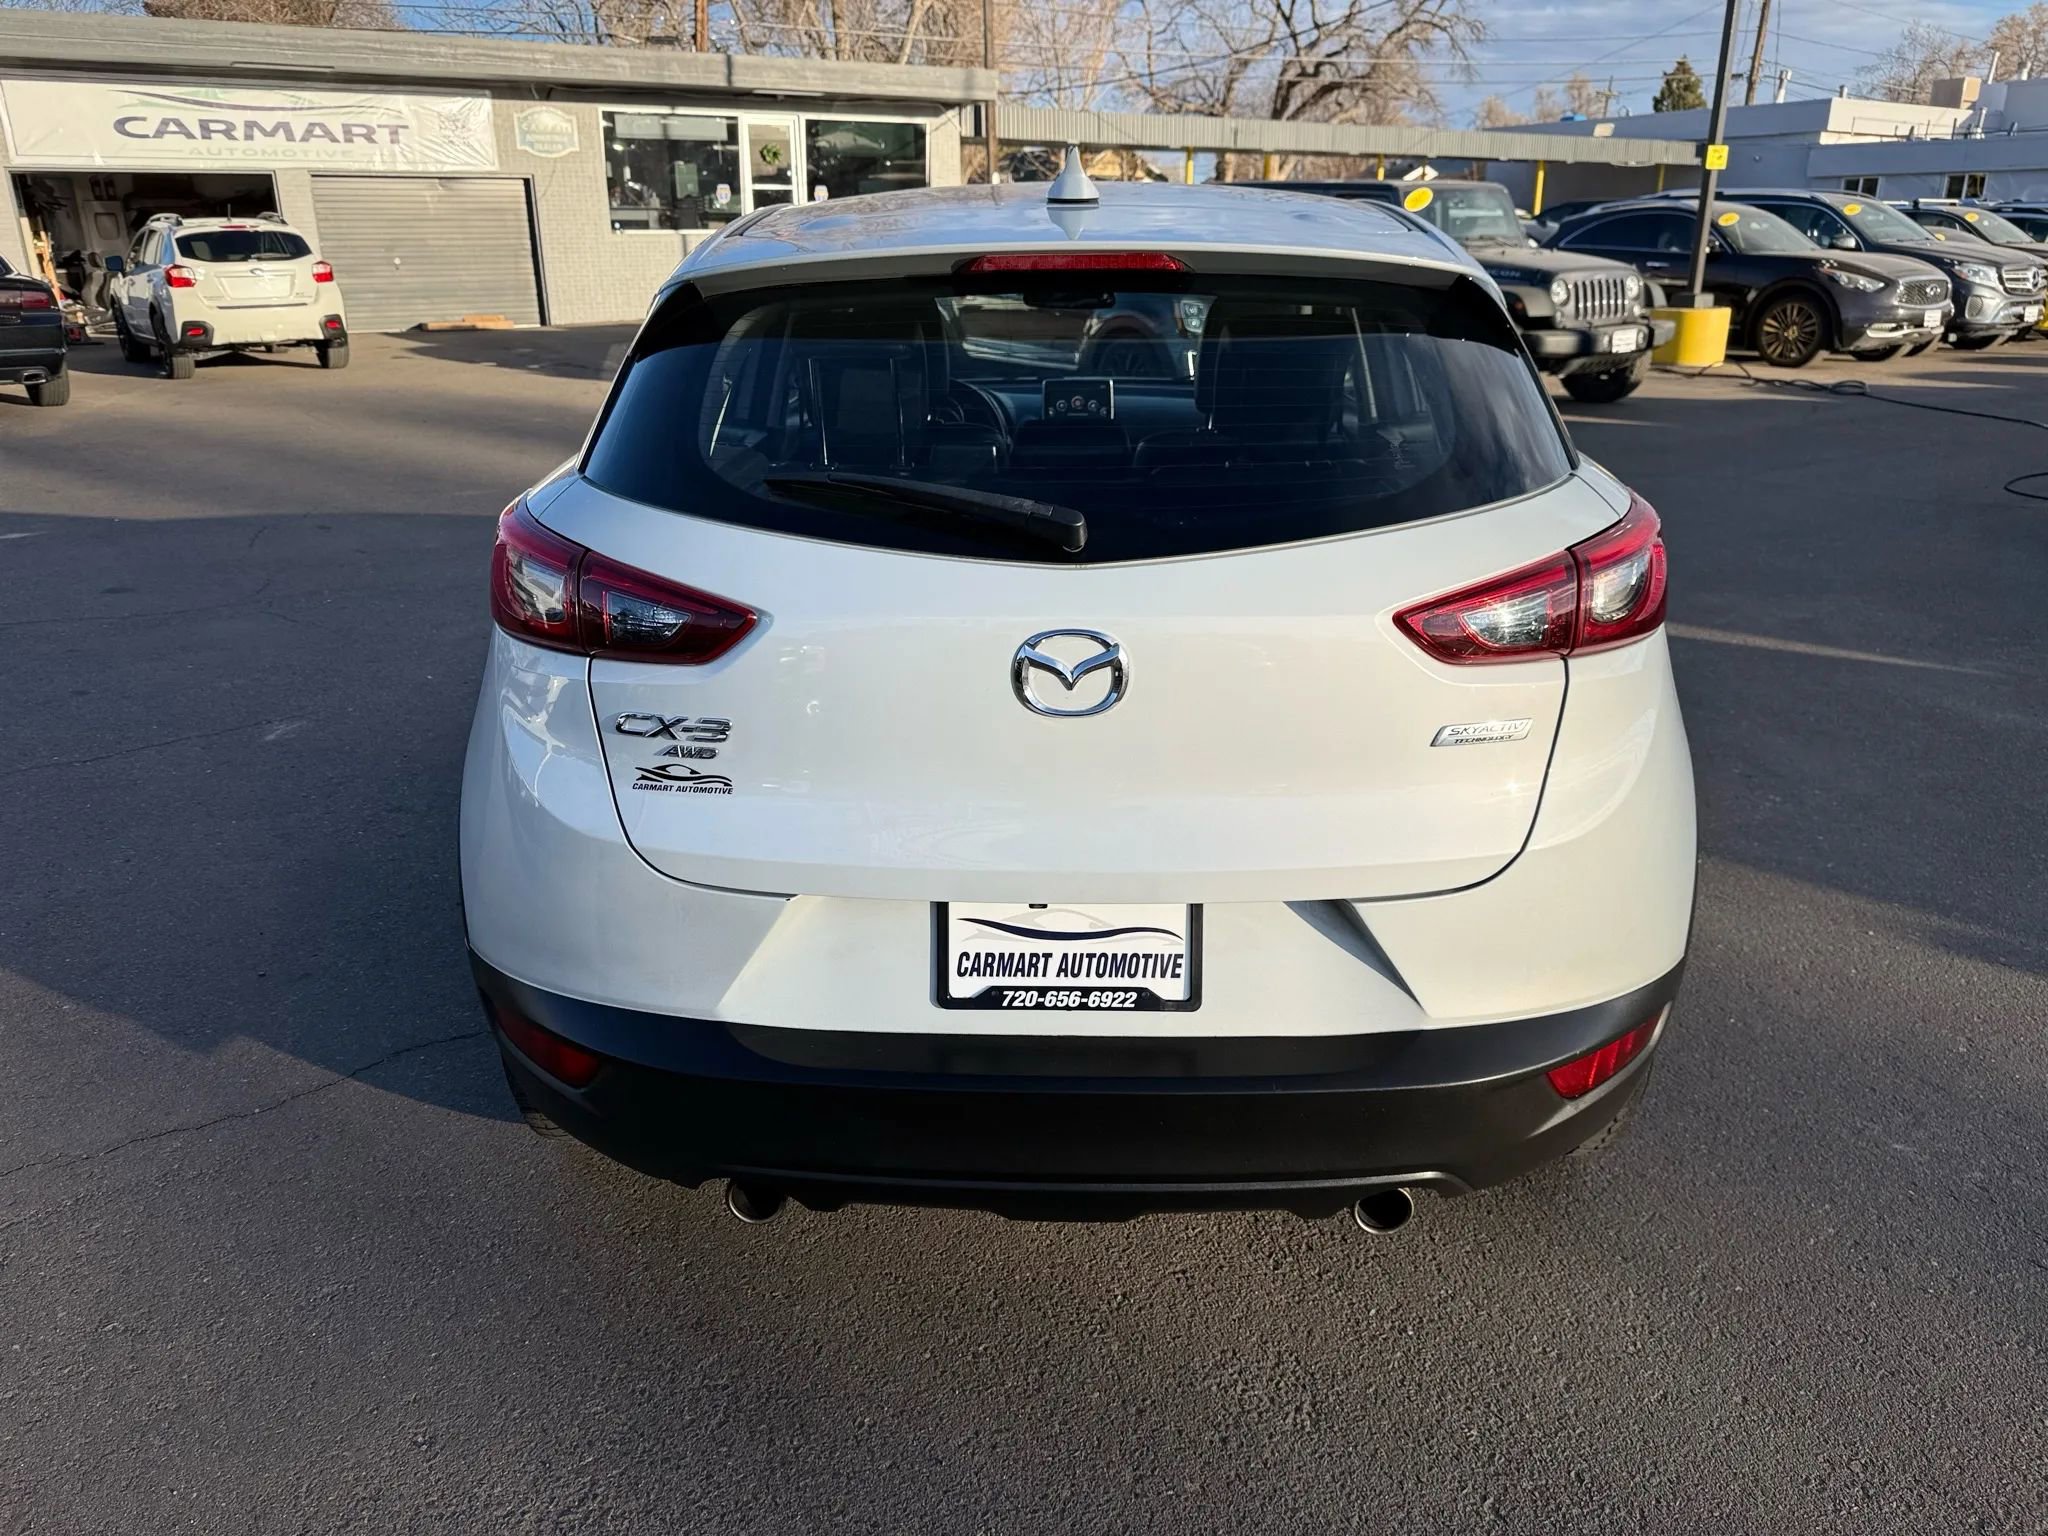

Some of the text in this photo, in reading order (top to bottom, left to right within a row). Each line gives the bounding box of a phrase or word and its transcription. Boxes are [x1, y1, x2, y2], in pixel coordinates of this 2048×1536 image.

[113, 115, 409, 145] CARMART
[188, 146, 355, 158] AUTOMOTIVE
[615, 711, 732, 743] CX-3
[1448, 720, 1525, 736] SKYACTIV
[658, 744, 719, 759] AWD
[632, 782, 734, 795] CARMART AUTOMOTIVE
[956, 951, 1184, 979] CARMART AUTOMOTIVE
[1002, 990, 1138, 1008] 720-656-6922
